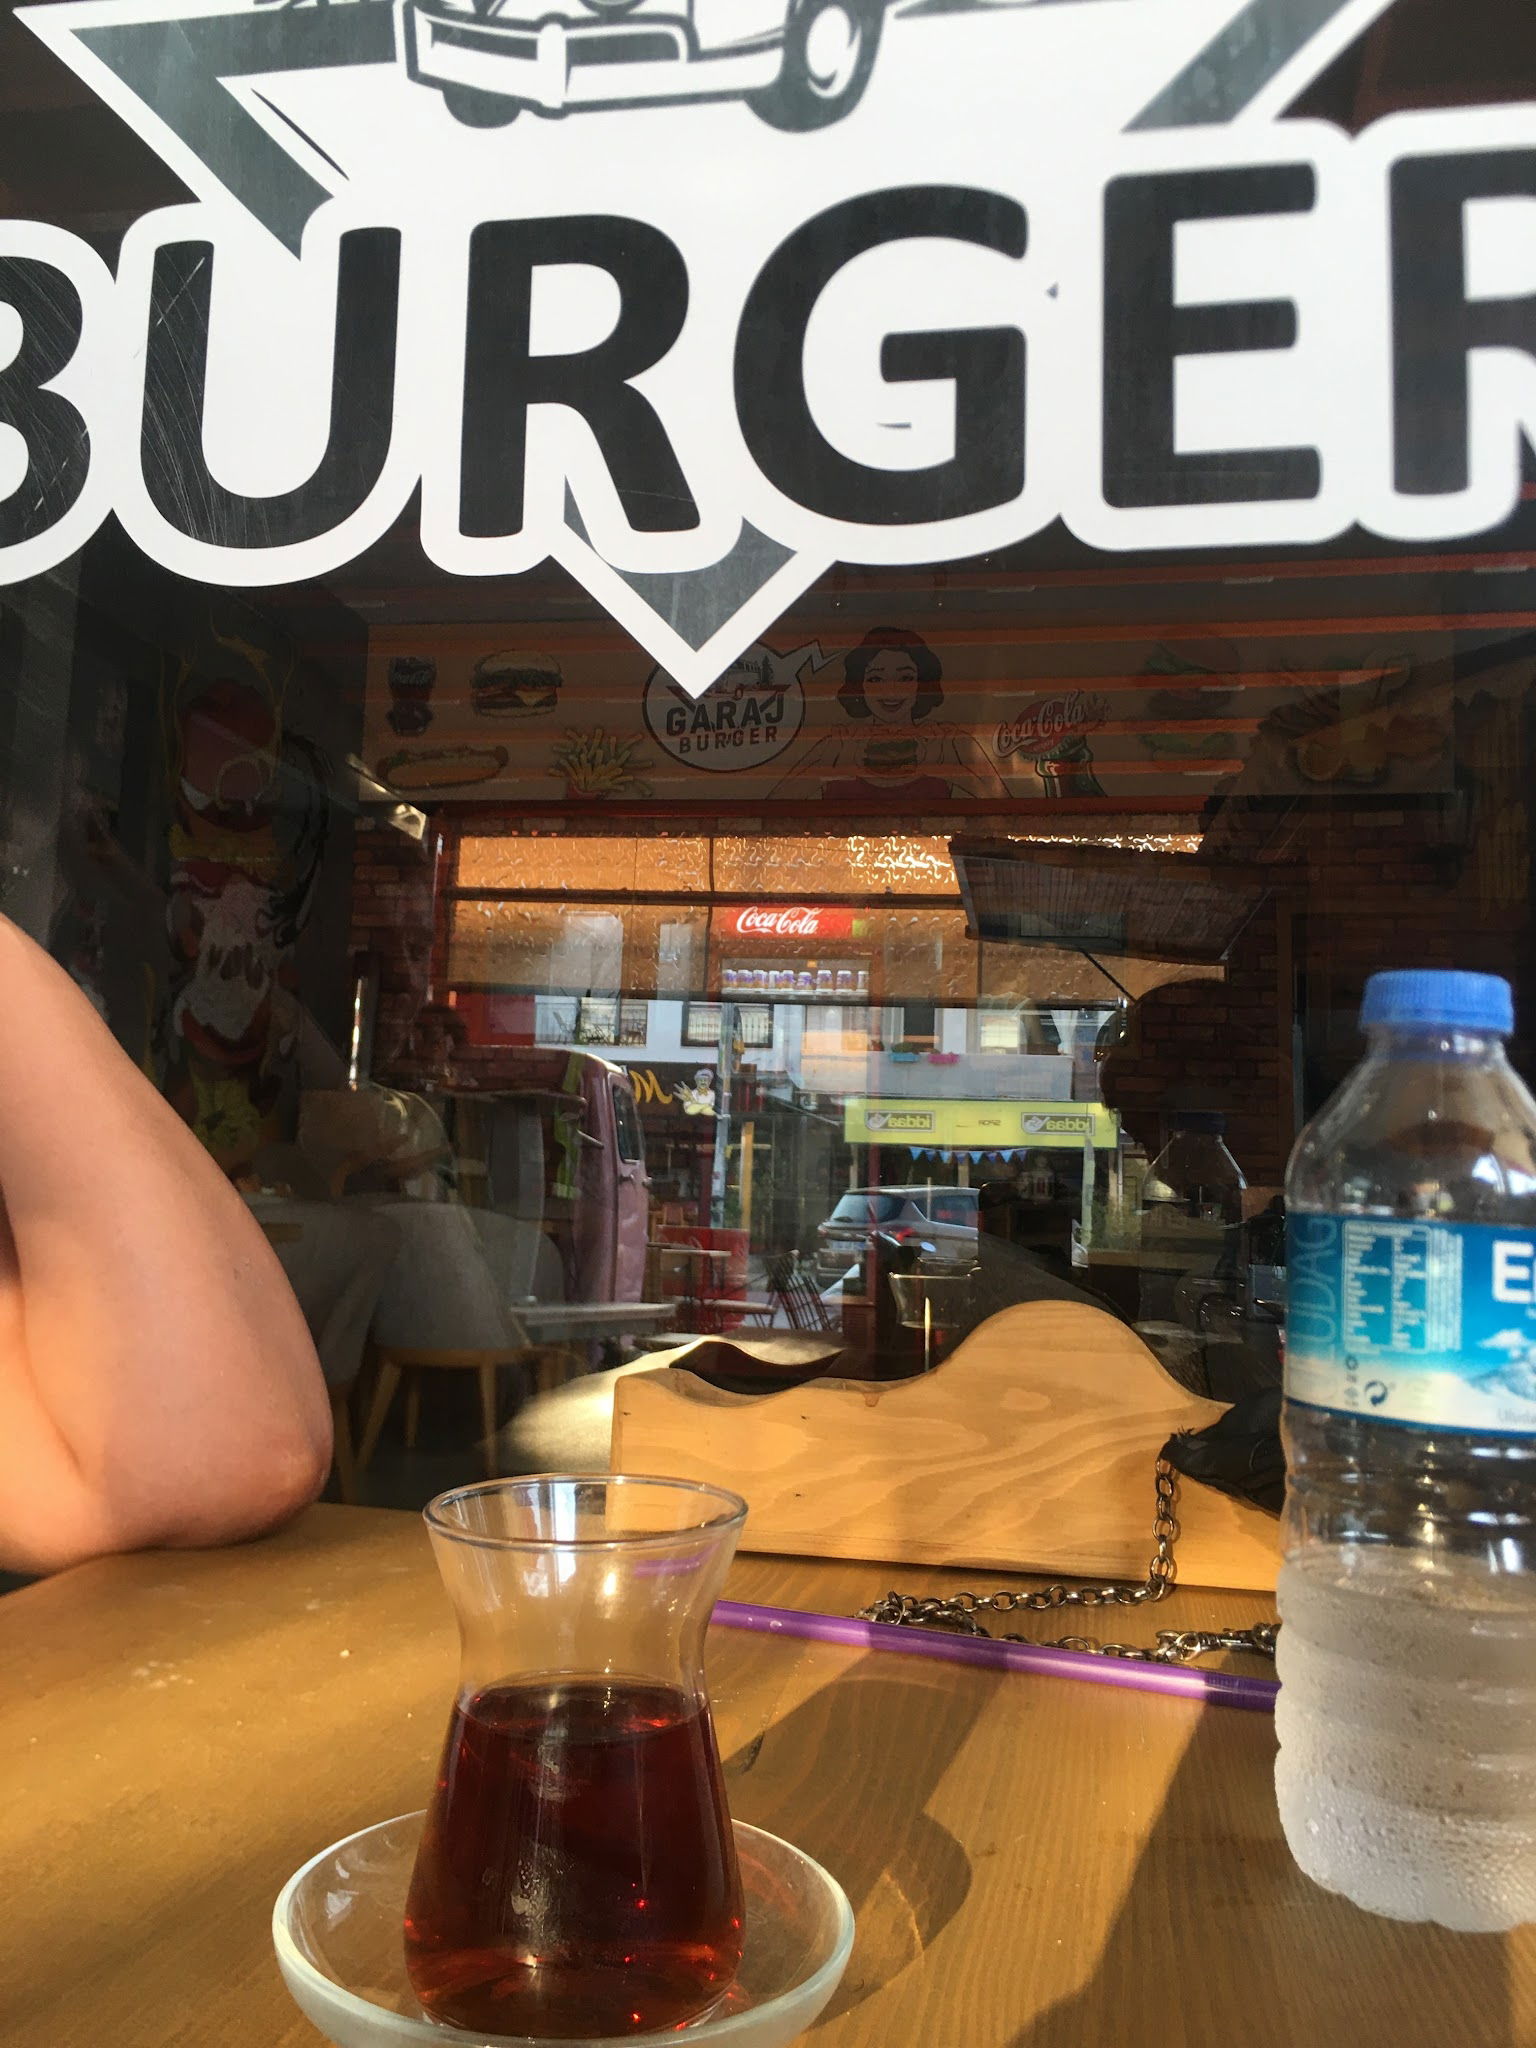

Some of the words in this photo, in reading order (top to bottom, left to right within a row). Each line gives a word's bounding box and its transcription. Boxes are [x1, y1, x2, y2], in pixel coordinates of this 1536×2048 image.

[666, 693, 784, 737] GARAJ
[993, 689, 1084, 757] Coca-Cola
[679, 725, 778, 753] BURGER
[736, 906, 824, 934] Coca-Cola
[1492, 1239, 1536, 1304] E
